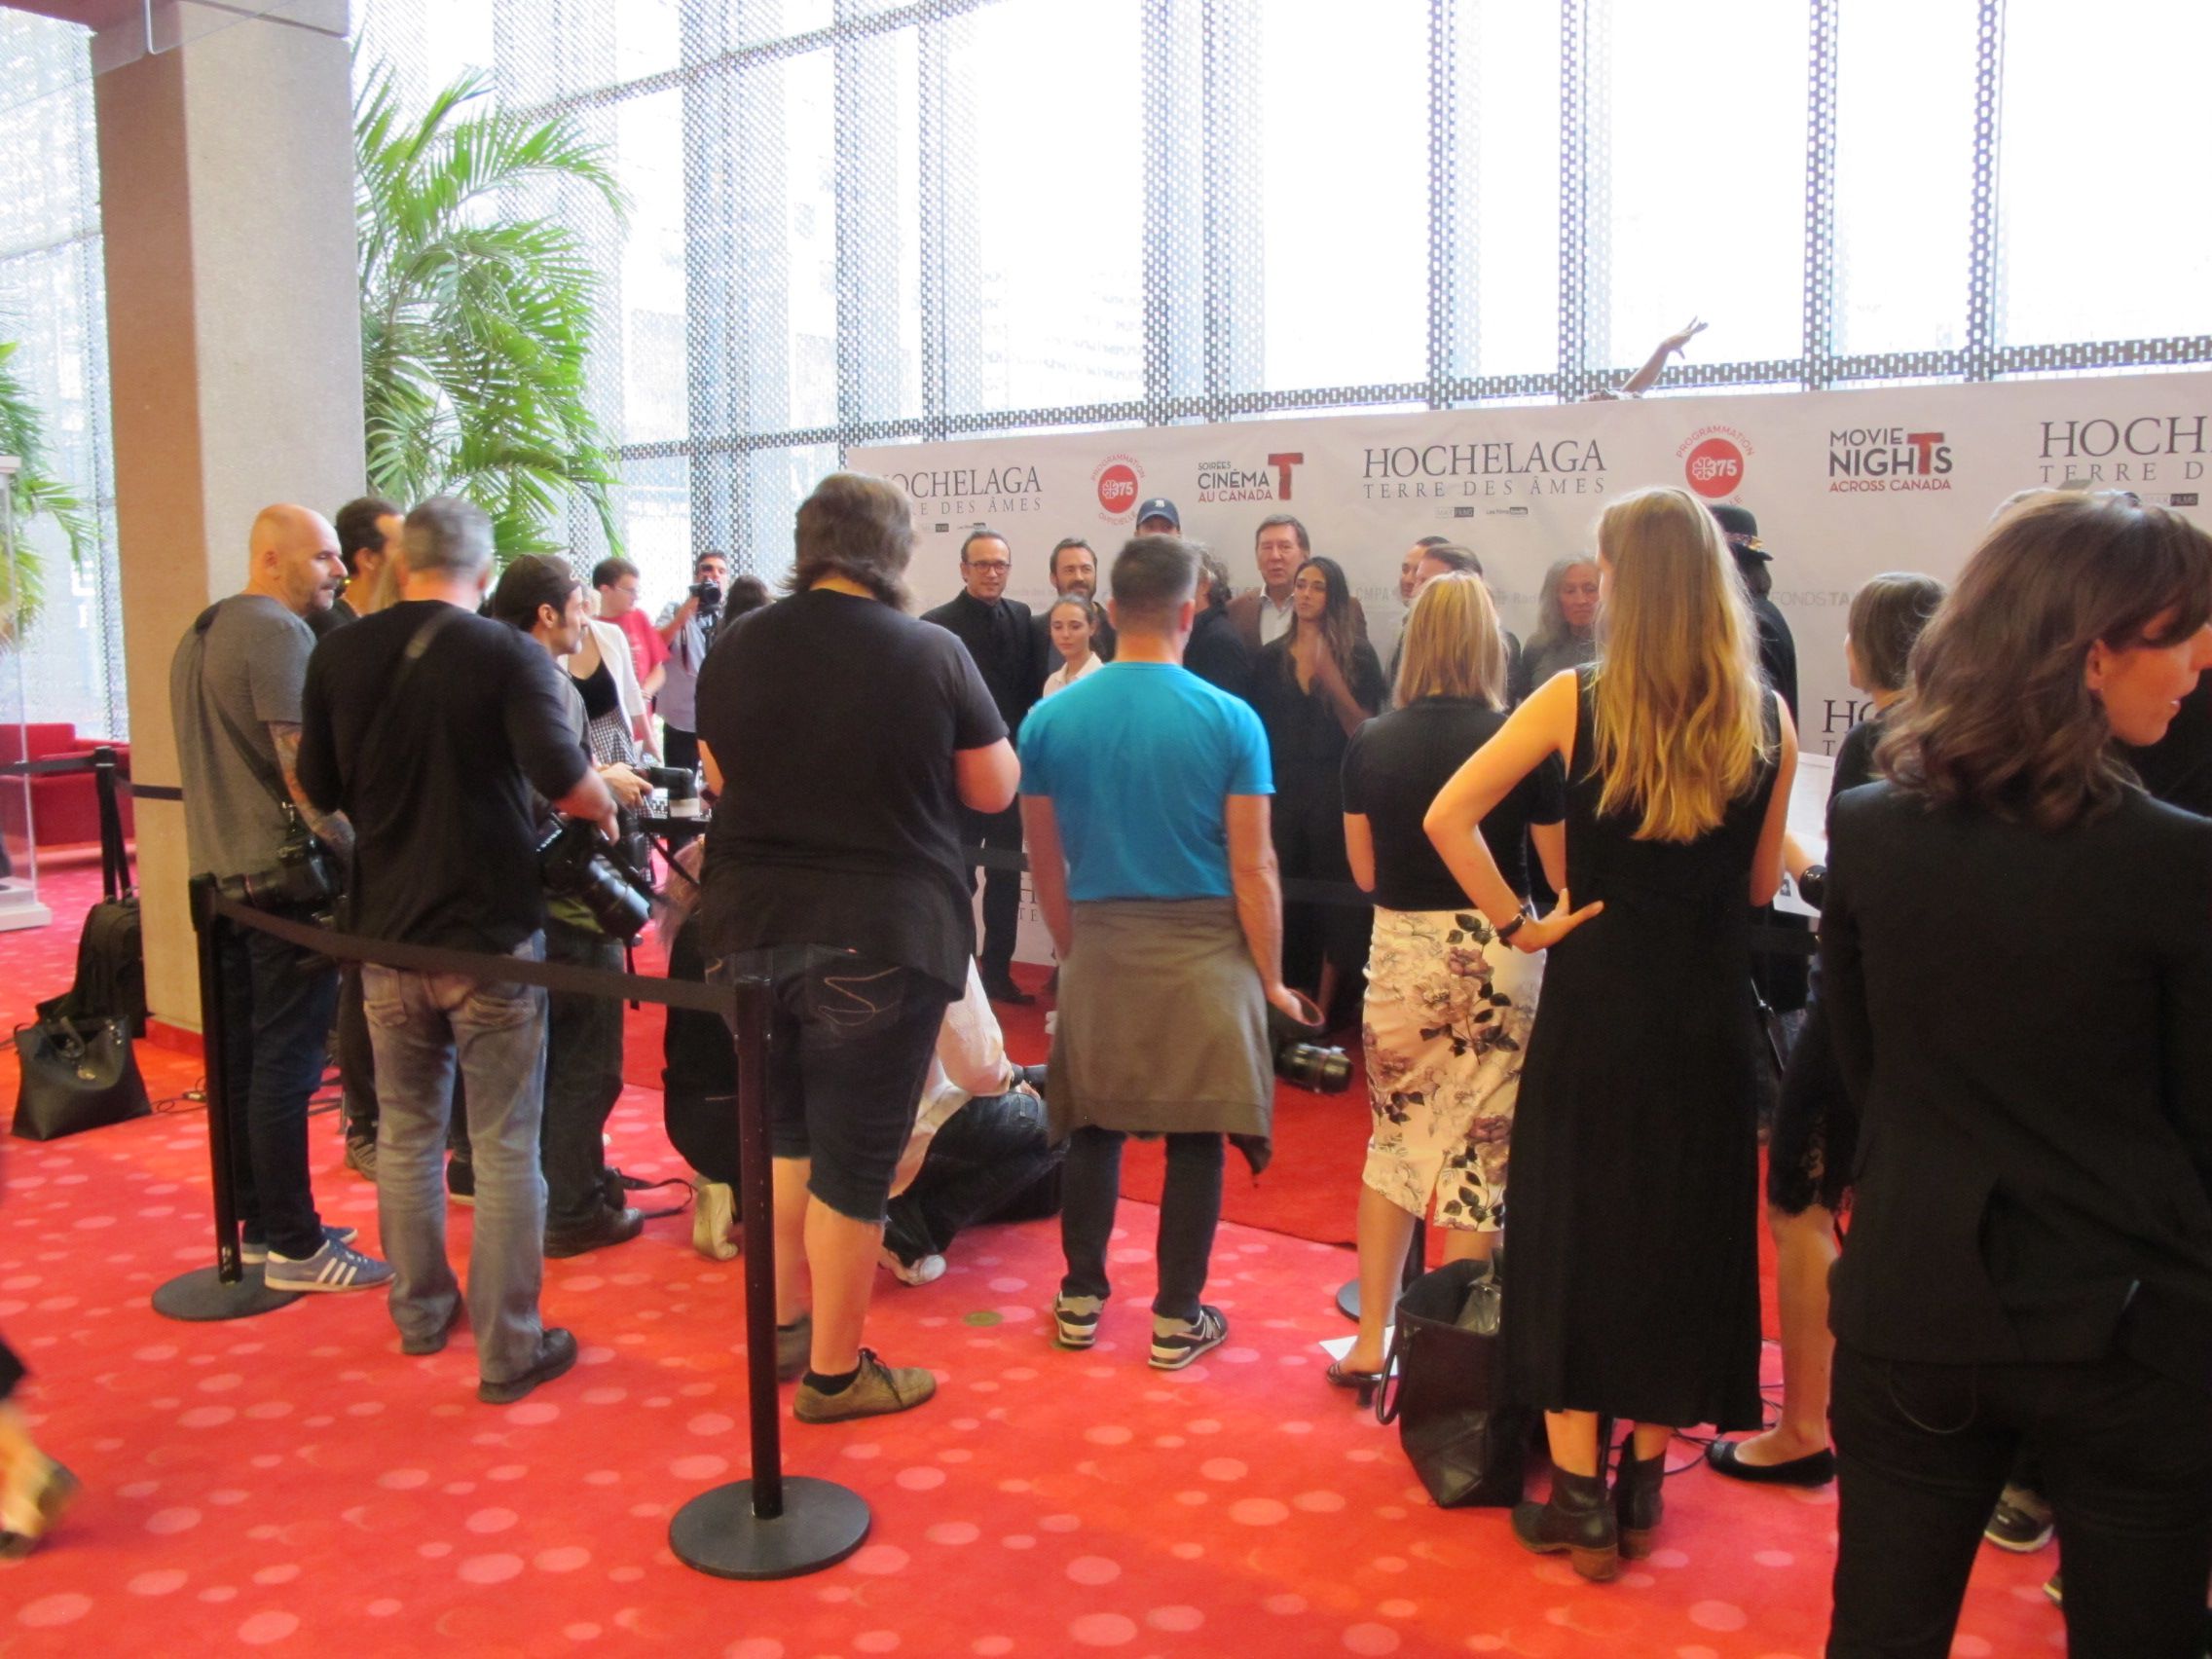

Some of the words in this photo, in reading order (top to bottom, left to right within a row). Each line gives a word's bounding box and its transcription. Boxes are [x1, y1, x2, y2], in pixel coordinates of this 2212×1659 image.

[1676, 424, 1755, 459] PROGRAMMATION
[1829, 427, 1903, 448] MOVIE
[2039, 416, 2212, 459] HOCH
[1363, 438, 1607, 478] HOCHELAGA
[1829, 432, 1953, 477] NIGHTS
[1198, 468, 1271, 490] CINÉMA
[1363, 481, 1446, 498] TERRE
[1463, 479, 1513, 497] DES
[1530, 475, 1604, 496] ÂMES
[1829, 479, 1886, 493] ACROSS
[1890, 478, 1952, 492] CANADA
[940, 500, 976, 515] DES
[988, 497, 1042, 513] ÂMES
[1198, 490, 1215, 503] AU
[1218, 489, 1273, 502] CANADA
